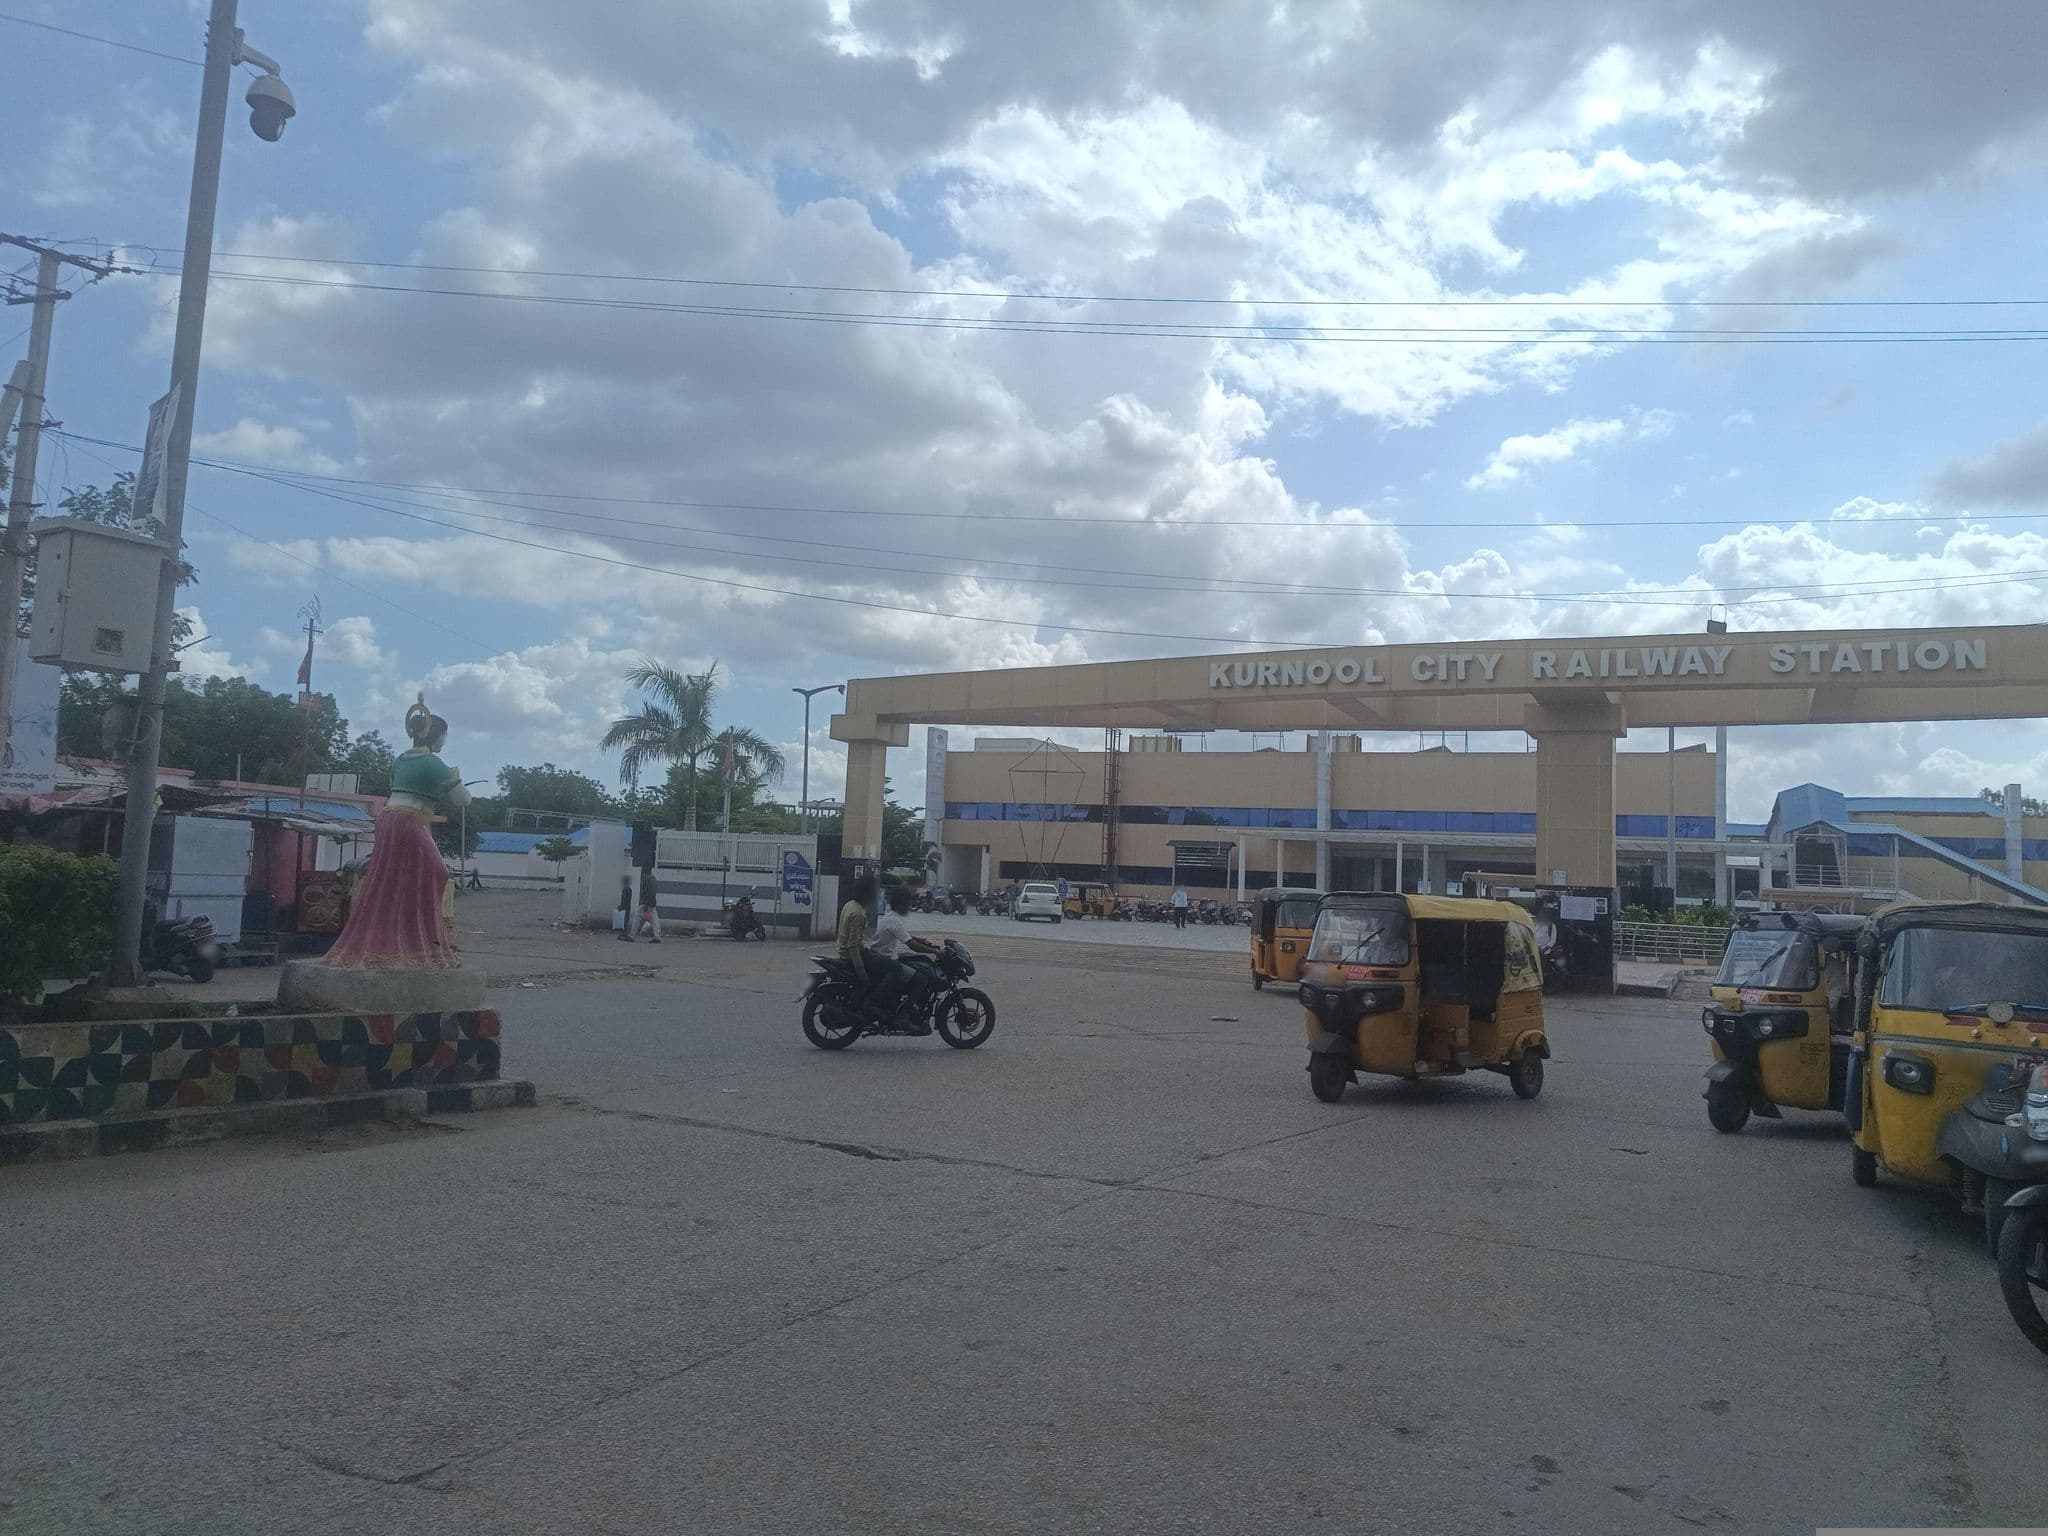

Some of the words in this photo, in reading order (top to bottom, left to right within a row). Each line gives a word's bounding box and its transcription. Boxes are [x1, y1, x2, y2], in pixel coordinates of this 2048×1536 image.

[1209, 656, 1385, 688] KURNOOL
[1411, 653, 1503, 682] CITY
[1531, 645, 1735, 680] RAILWAY
[1769, 639, 1988, 674] STATION
